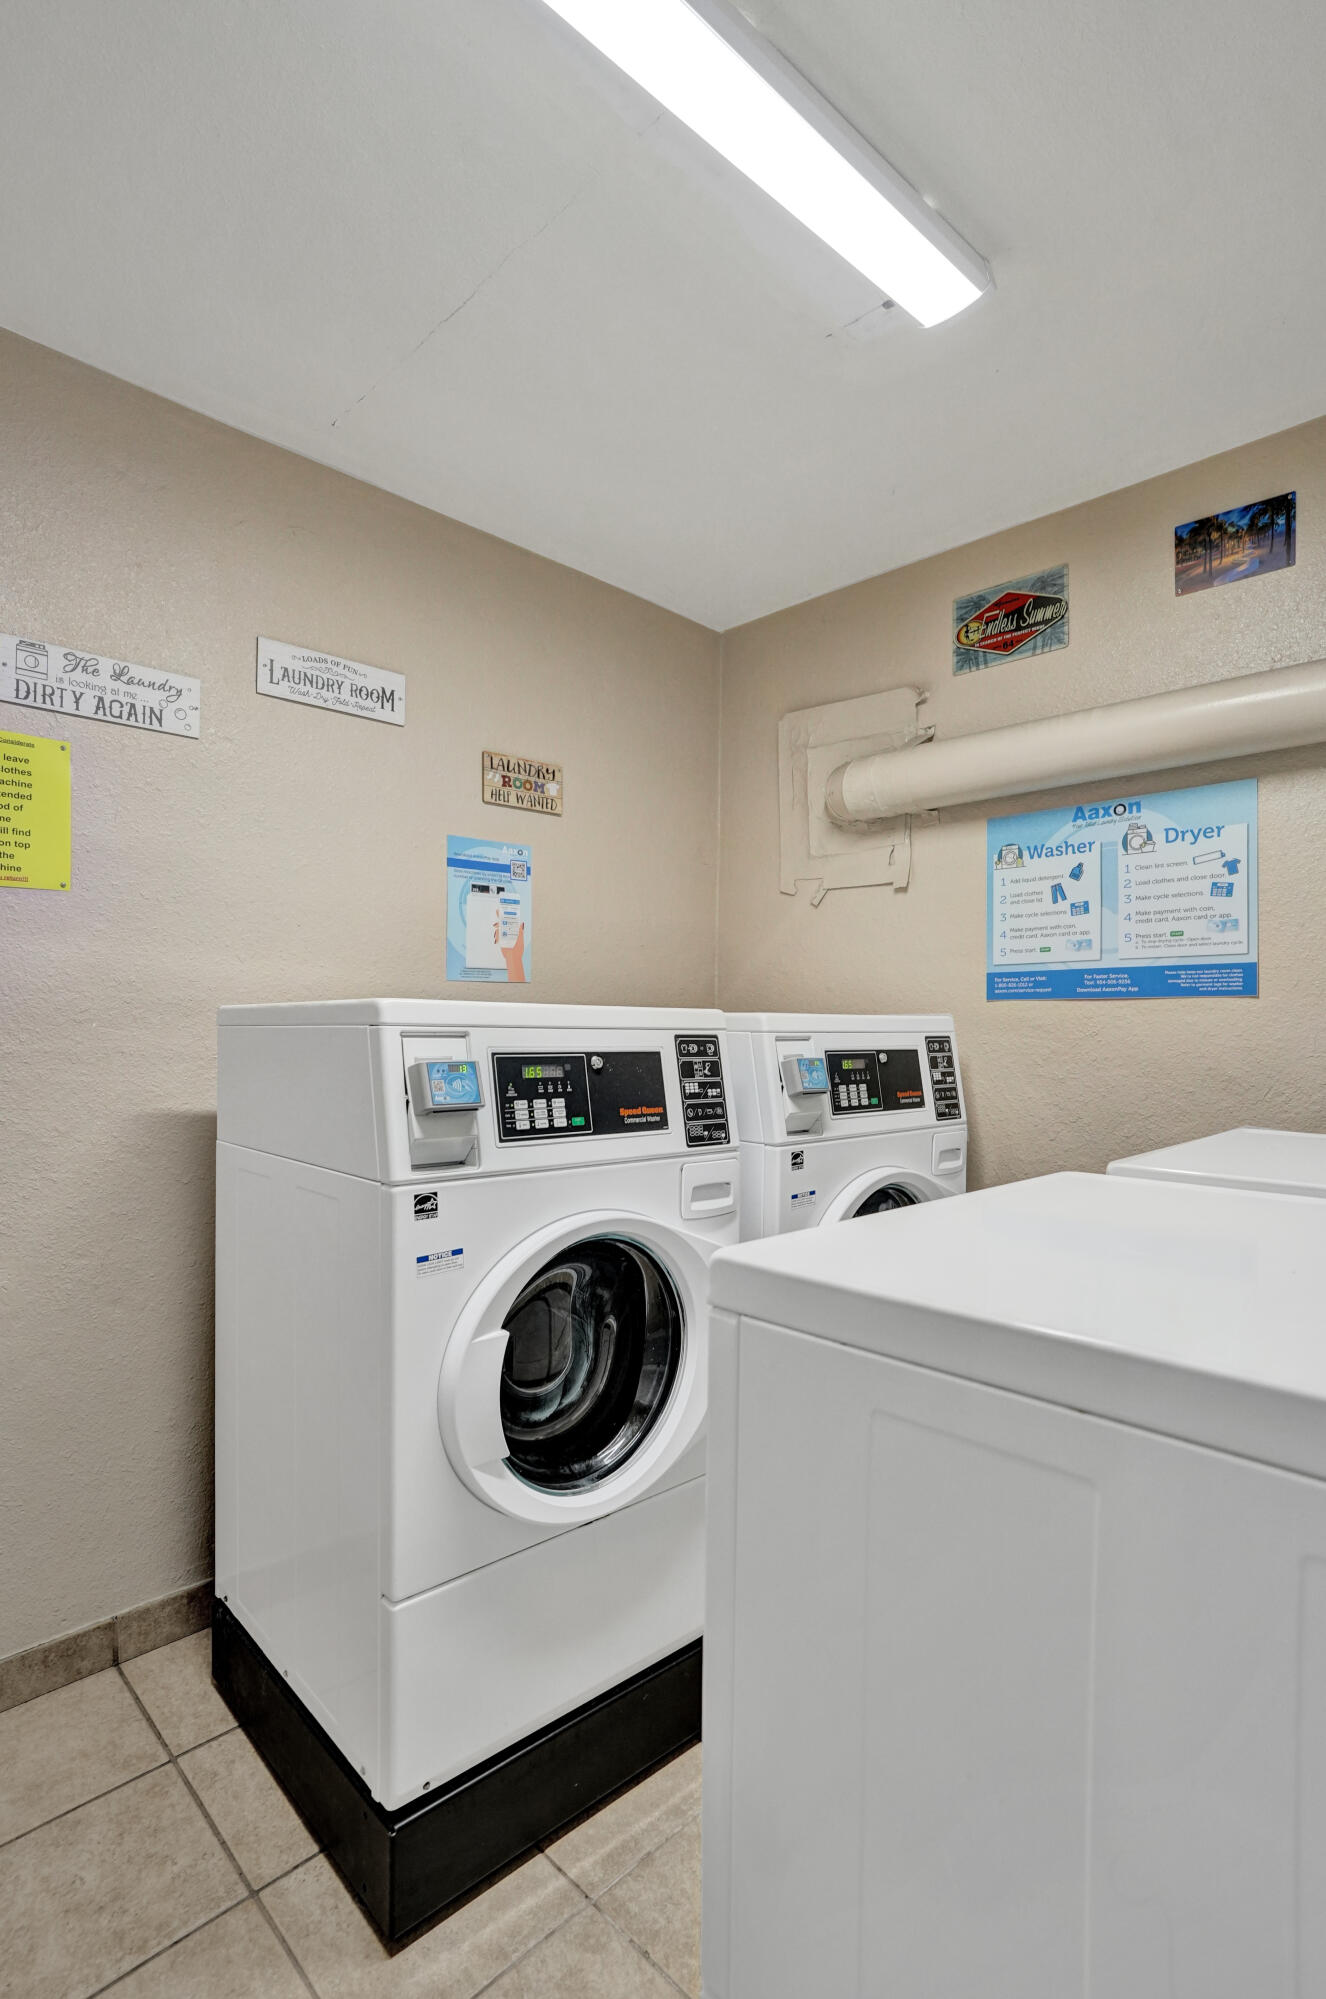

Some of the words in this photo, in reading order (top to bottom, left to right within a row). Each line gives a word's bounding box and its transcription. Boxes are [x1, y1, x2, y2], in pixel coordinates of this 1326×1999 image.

[979, 608, 1018, 638] Endless
[1020, 598, 1067, 626] Summer
[302, 655, 329, 665] LOADS
[330, 659, 342, 668] OF
[343, 663, 358, 676] FUN
[62, 652, 100, 677] The
[110, 663, 182, 703] Laundry
[55, 676, 64, 684] is
[68, 676, 107, 696] looking
[110, 686, 120, 696] at
[268, 658, 344, 695] LAUNDRY
[350, 682, 396, 712] ROOM
[14, 678, 86, 712] DIRTY
[93, 694, 164, 728] AGAIN
[3, 753, 30, 764] leave
[1, 766, 32, 776] lothes
[490, 755, 555, 782] LAUNDRY
[0, 779, 32, 788] achine
[501, 774, 546, 794] ROOM
[491, 788, 512, 804] HELP
[516, 792, 558, 811] WANTED
[13, 804, 24, 812] of
[1072, 800, 1142, 822] Aaxon
[12, 828, 31, 836] find
[1164, 825, 1224, 845] Dryer
[14, 840, 30, 850] top
[1026, 840, 1096, 860] Washer
[0, 864, 22, 872] hine
[1124, 864, 1130, 874] 1
[1000, 878, 1006, 886] 1
[1124, 879, 1132, 888] 2
[1000, 896, 1006, 904] 2
[1124, 894, 1132, 904] 3
[1152, 894, 1170, 902] cycle
[1000, 913, 1006, 922] 3
[1124, 913, 1132, 922] 4
[1153, 908, 1180, 916] payment
[1000, 932, 1006, 940] 4
[1024, 926, 1048, 934] payment
[1124, 933, 1132, 942] 5
[1000, 948, 1006, 956] 5
[620, 1107, 642, 1116] Speed
[624, 1116, 646, 1124] Commercial
[428, 1250, 452, 1262] NOTICE
